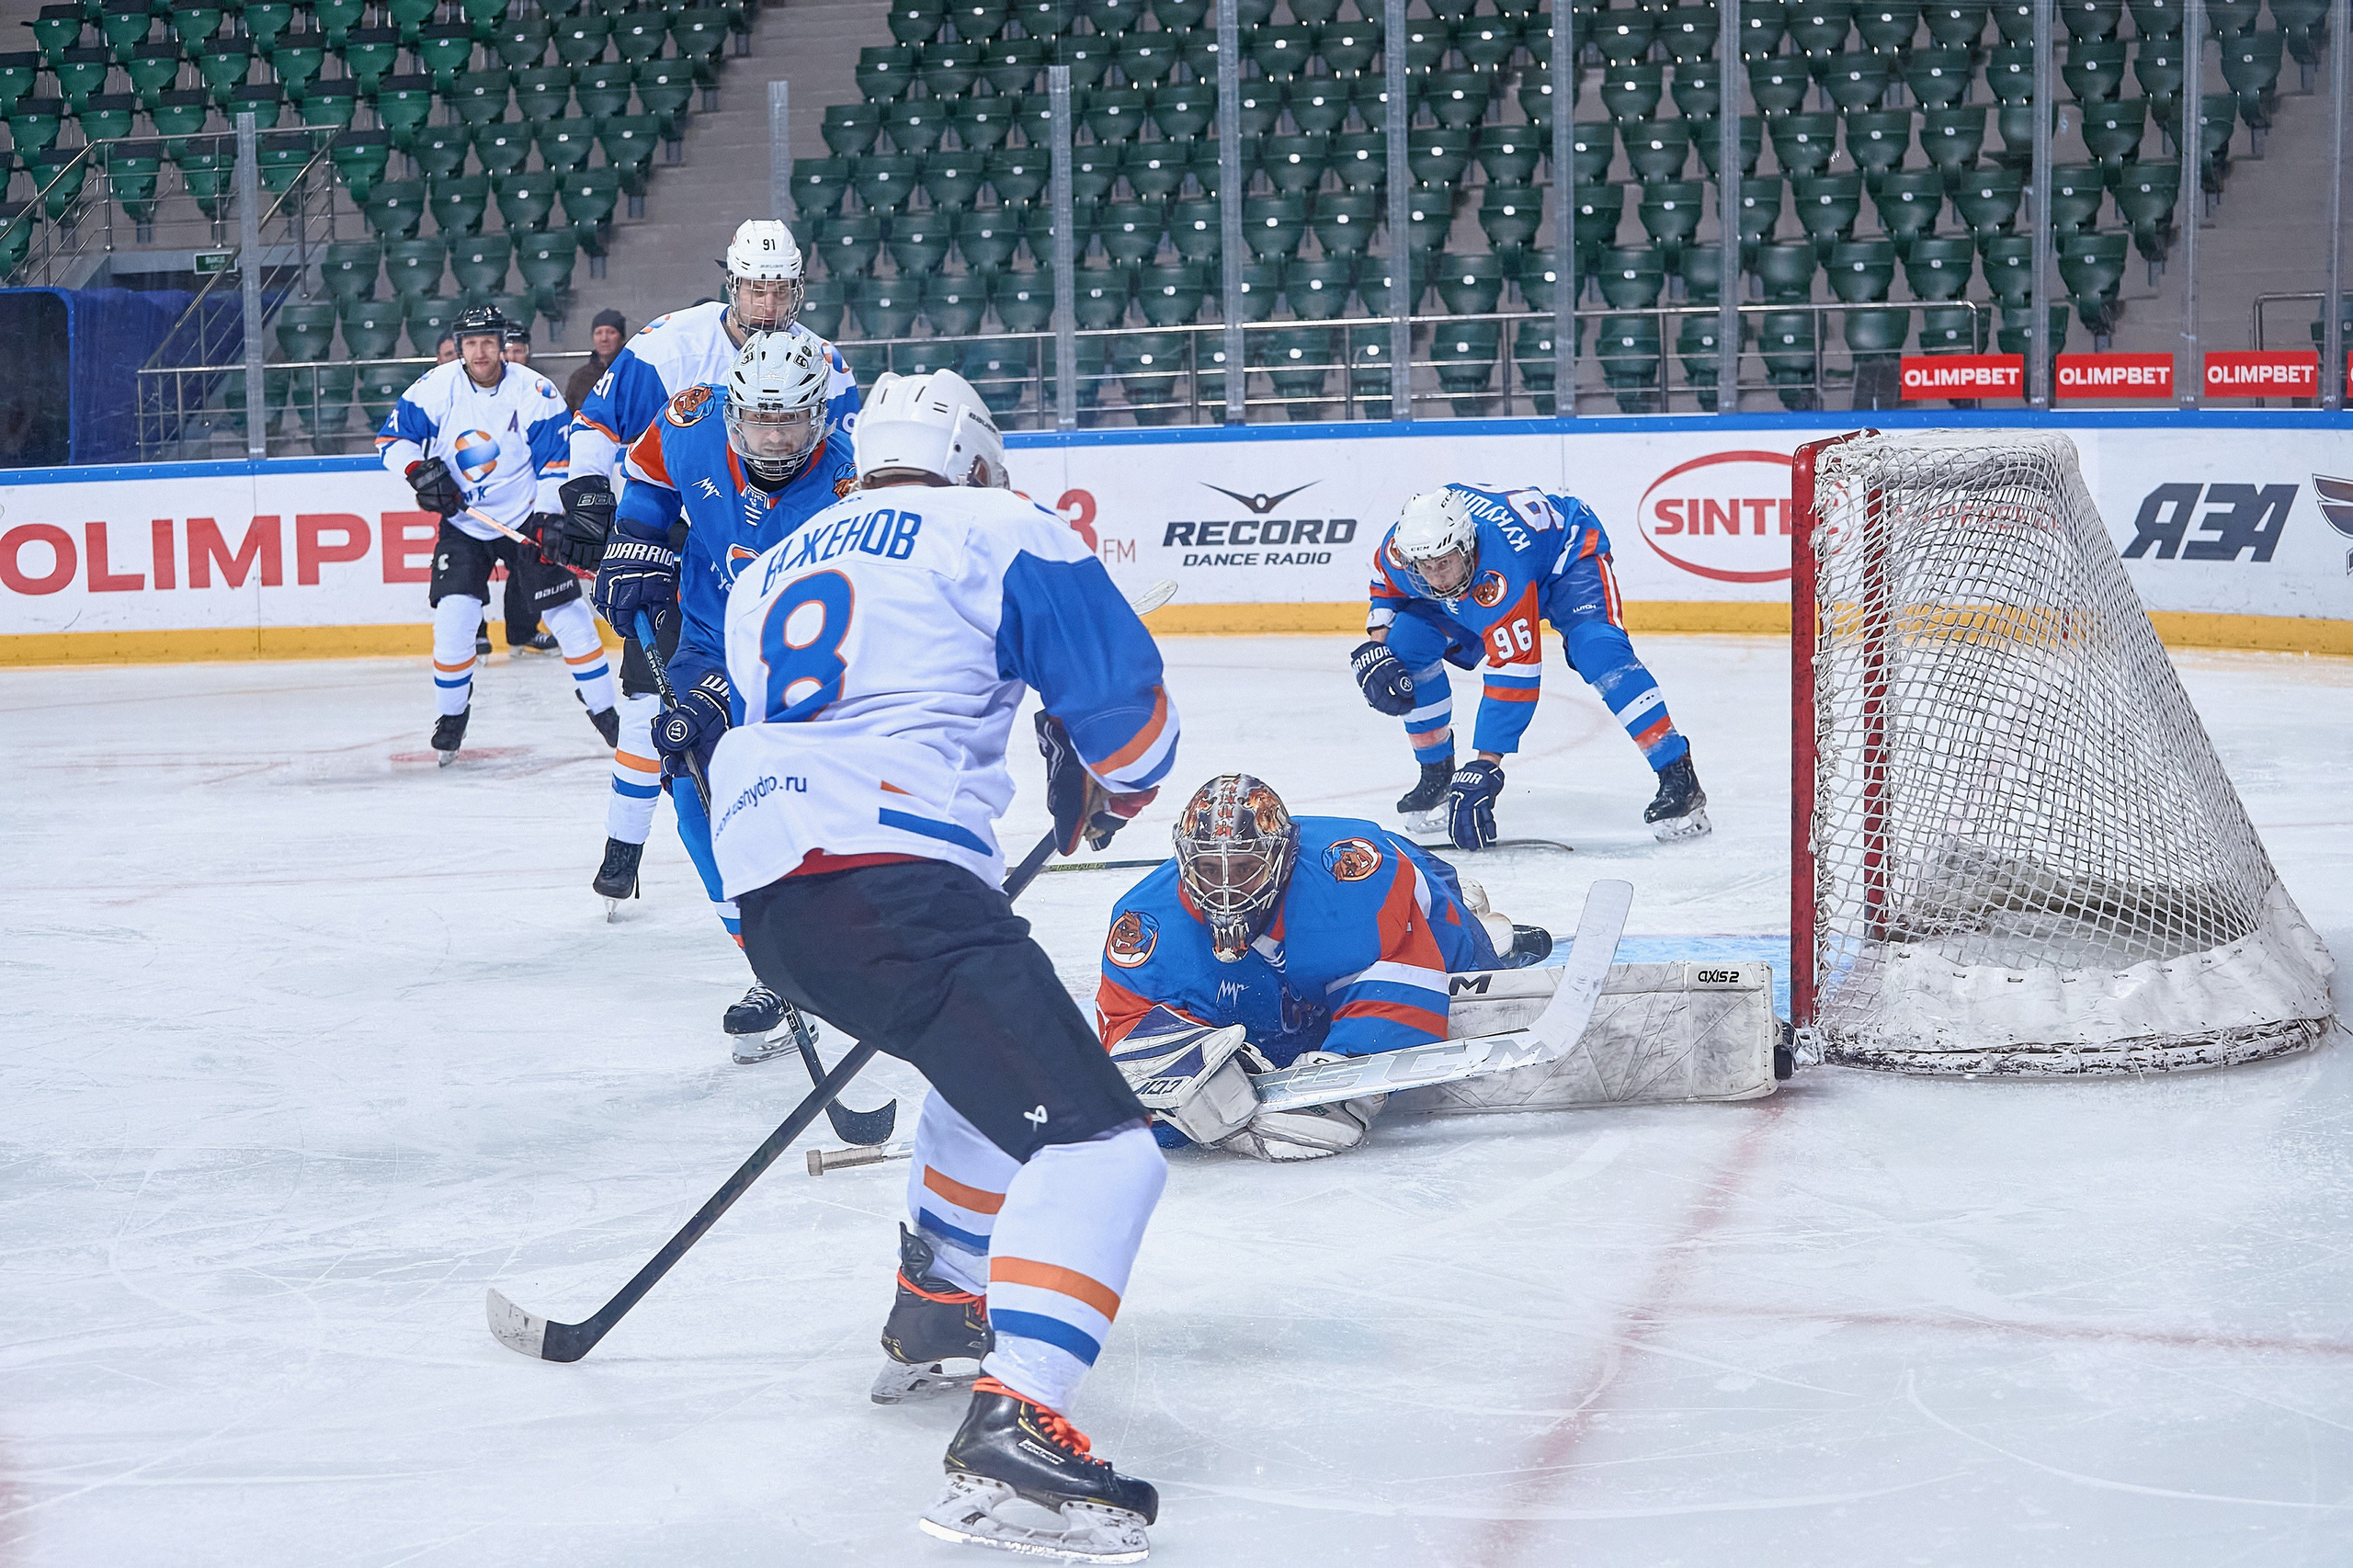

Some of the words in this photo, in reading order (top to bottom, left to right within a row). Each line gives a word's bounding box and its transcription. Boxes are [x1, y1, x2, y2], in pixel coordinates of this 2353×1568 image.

[762, 238, 776, 251] 91
[1904, 367, 2020, 387] OLIMPBET
[2059, 366, 2171, 386] OLIMPBET
[2207, 365, 2314, 383] OLIMPBET
[507, 410, 518, 433] A
[1451, 488, 1532, 552] КУКУШ
[1654, 498, 1839, 536] SINT
[1163, 518, 1358, 547] RECORD
[0, 510, 511, 595] OLIMPB
[602, 542, 676, 571] WARRIO
[759, 508, 923, 598] БАЖЕНОВ
[1103, 539, 1136, 563] FM
[1183, 552, 1259, 566] DANCE
[1265, 551, 1332, 565] RADIO
[534, 579, 574, 600] BAUER
[759, 568, 856, 724] 8
[1492, 618, 1533, 660] 96
[1449, 771, 1484, 785] RIOR
